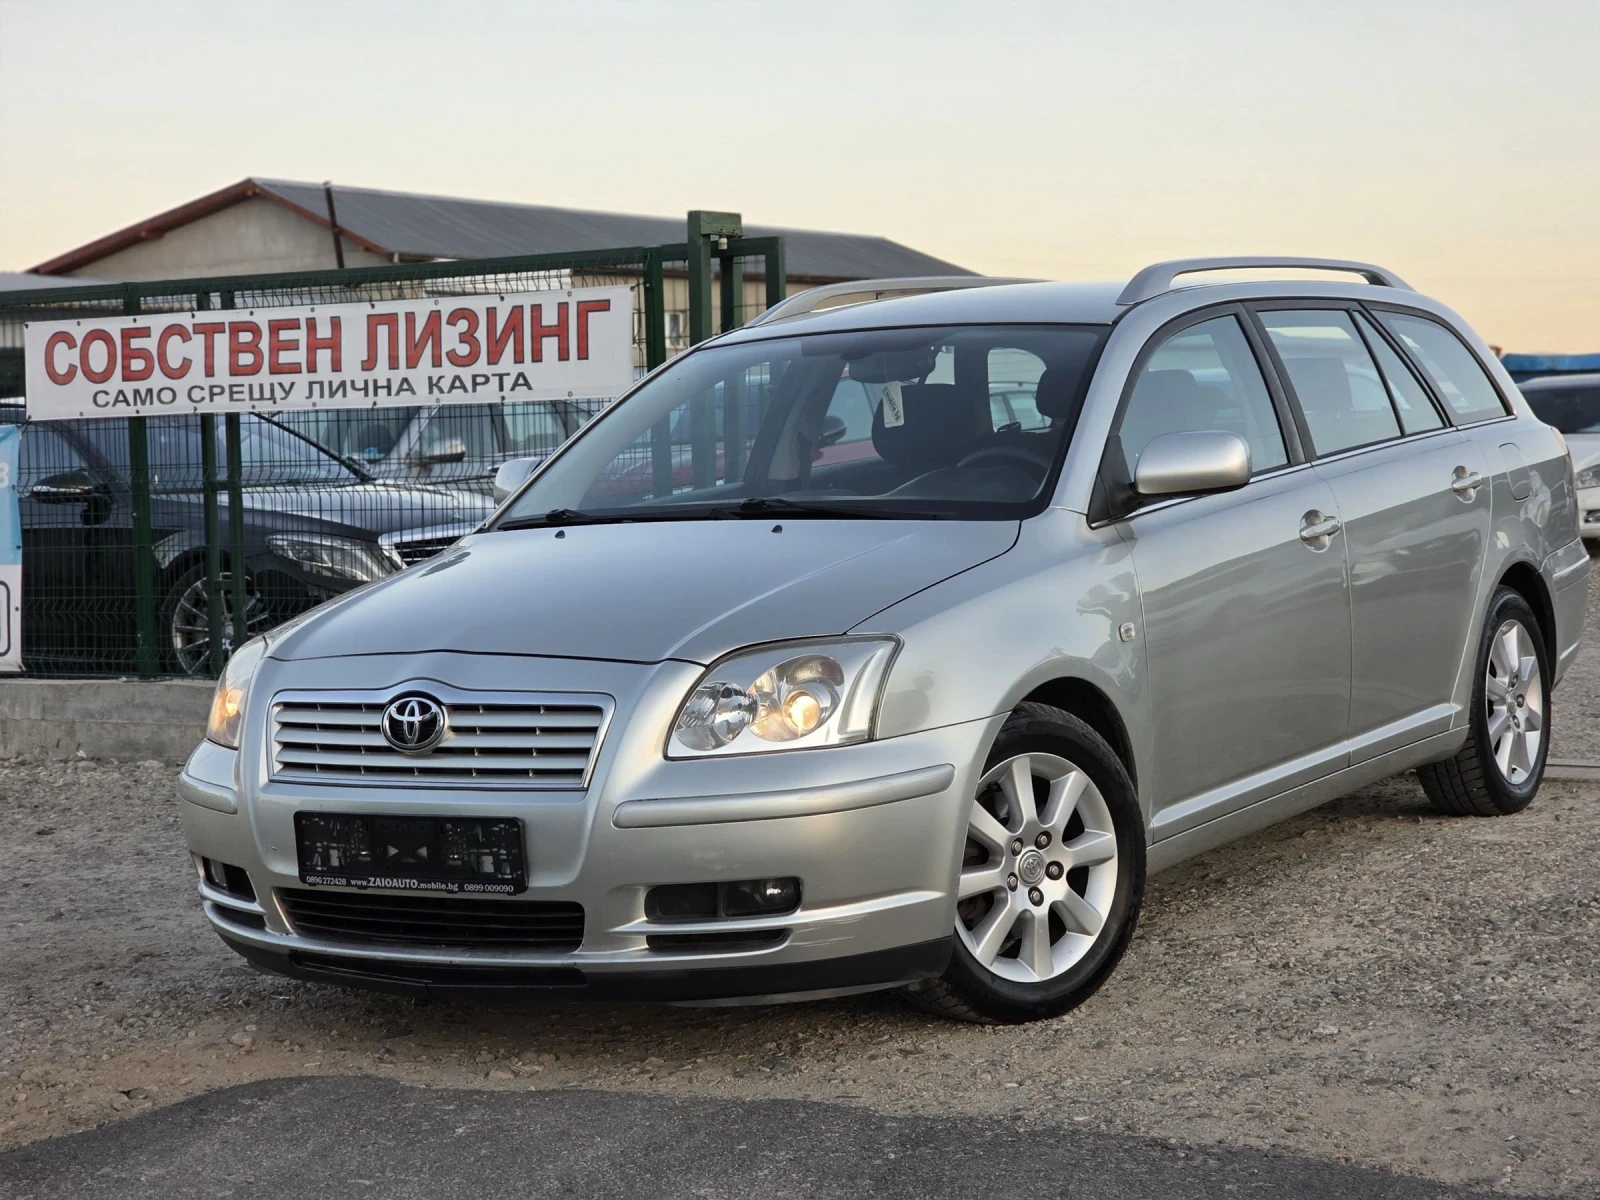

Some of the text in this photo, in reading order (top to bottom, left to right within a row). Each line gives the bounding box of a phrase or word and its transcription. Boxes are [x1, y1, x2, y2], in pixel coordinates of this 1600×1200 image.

[44, 299, 611, 386] СОБСТВЕН ЛИЗИНГ
[92, 371, 533, 408] САМО СРЕЩУ ЛИЧНА КАРТА
[464, 883, 484, 892] 0899
[484, 884, 514, 893] 009090
